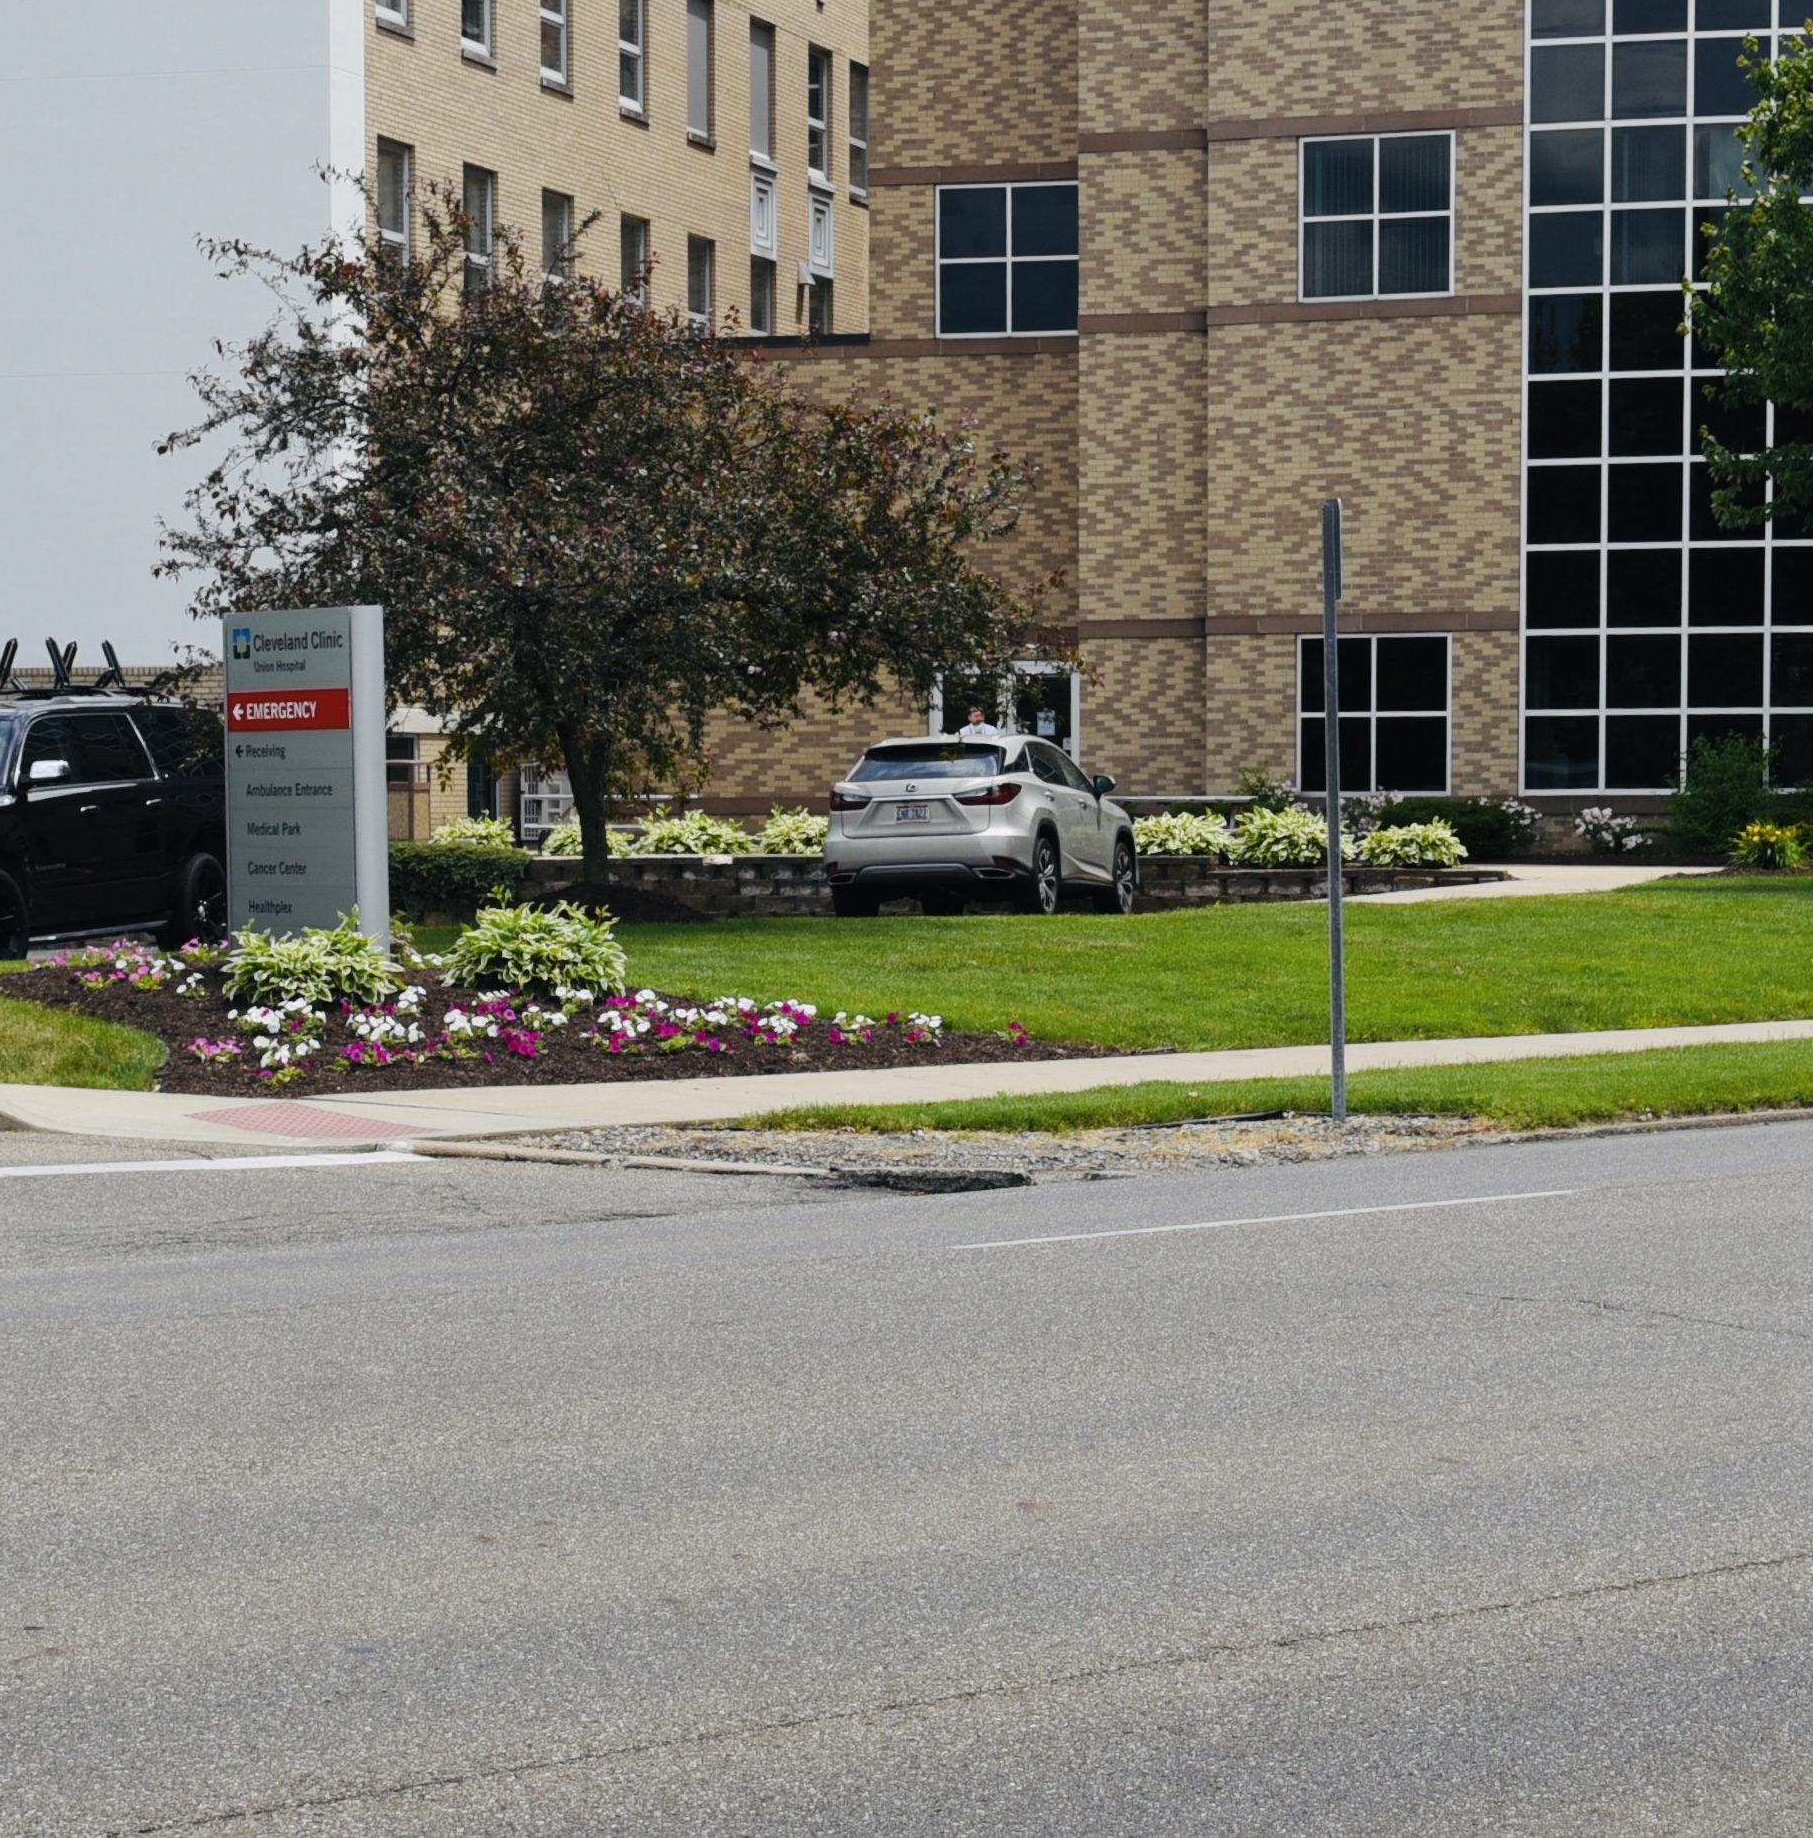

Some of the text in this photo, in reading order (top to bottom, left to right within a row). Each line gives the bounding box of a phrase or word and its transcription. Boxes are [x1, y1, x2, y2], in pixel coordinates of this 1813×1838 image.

[253, 630, 343, 652] Cleveland Clinic
[253, 659, 306, 673] Union Hospital
[246, 701, 317, 720] EMERGENCY
[246, 744, 286, 760] Receiving
[246, 783, 333, 797] Ambulance Entrance
[247, 822, 301, 836] Medical Park
[247, 861, 307, 875] Cancer Center
[248, 900, 293, 916] Healthplex
